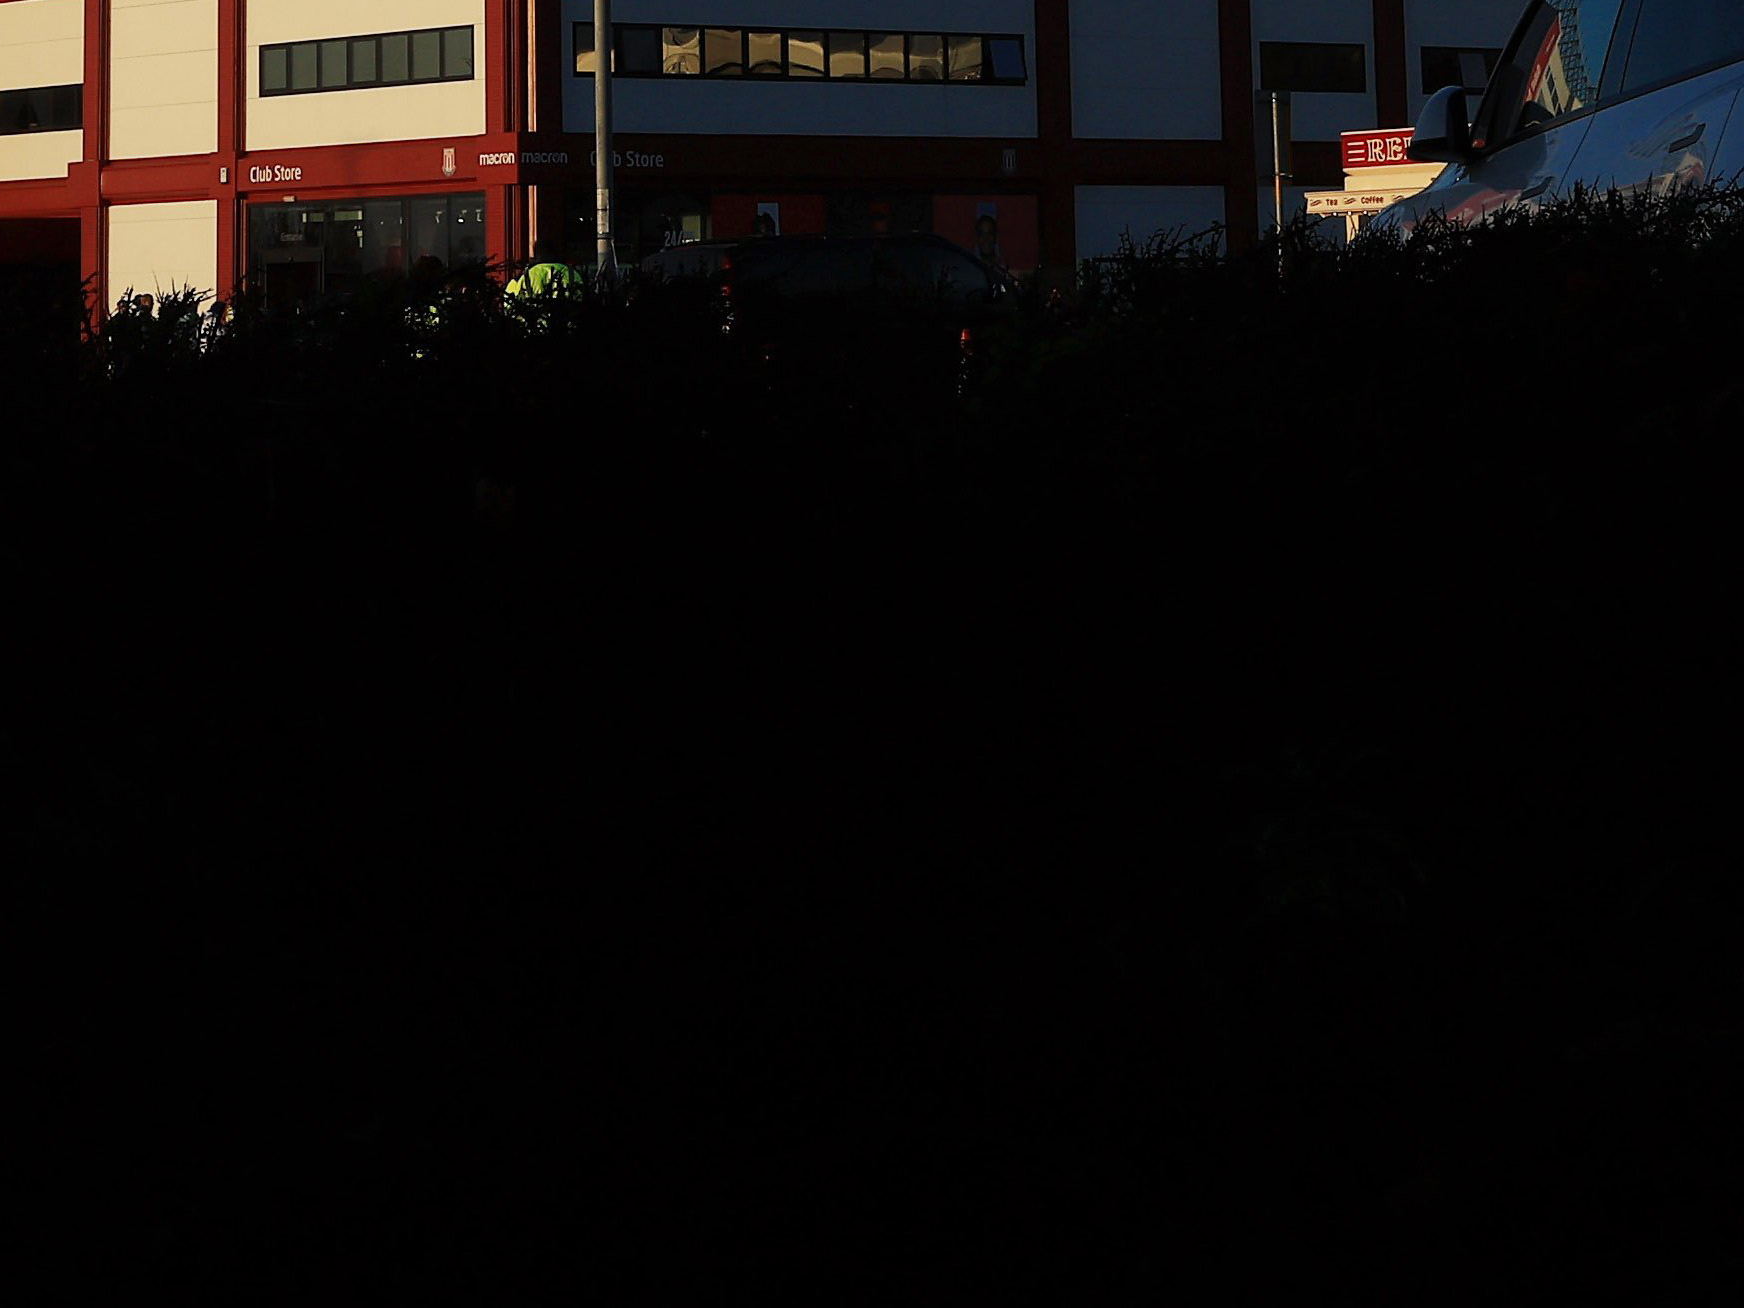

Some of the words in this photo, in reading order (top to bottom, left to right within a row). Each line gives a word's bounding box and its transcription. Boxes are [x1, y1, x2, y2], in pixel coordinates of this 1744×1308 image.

[479, 151, 516, 166] macron
[520, 151, 569, 164] macron
[590, 150, 622, 167] Cb
[625, 150, 664, 168] Store
[249, 165, 273, 183] Club
[273, 164, 302, 182] Store
[1326, 198, 1338, 206] Tea
[1360, 196, 1384, 205] Coffee
